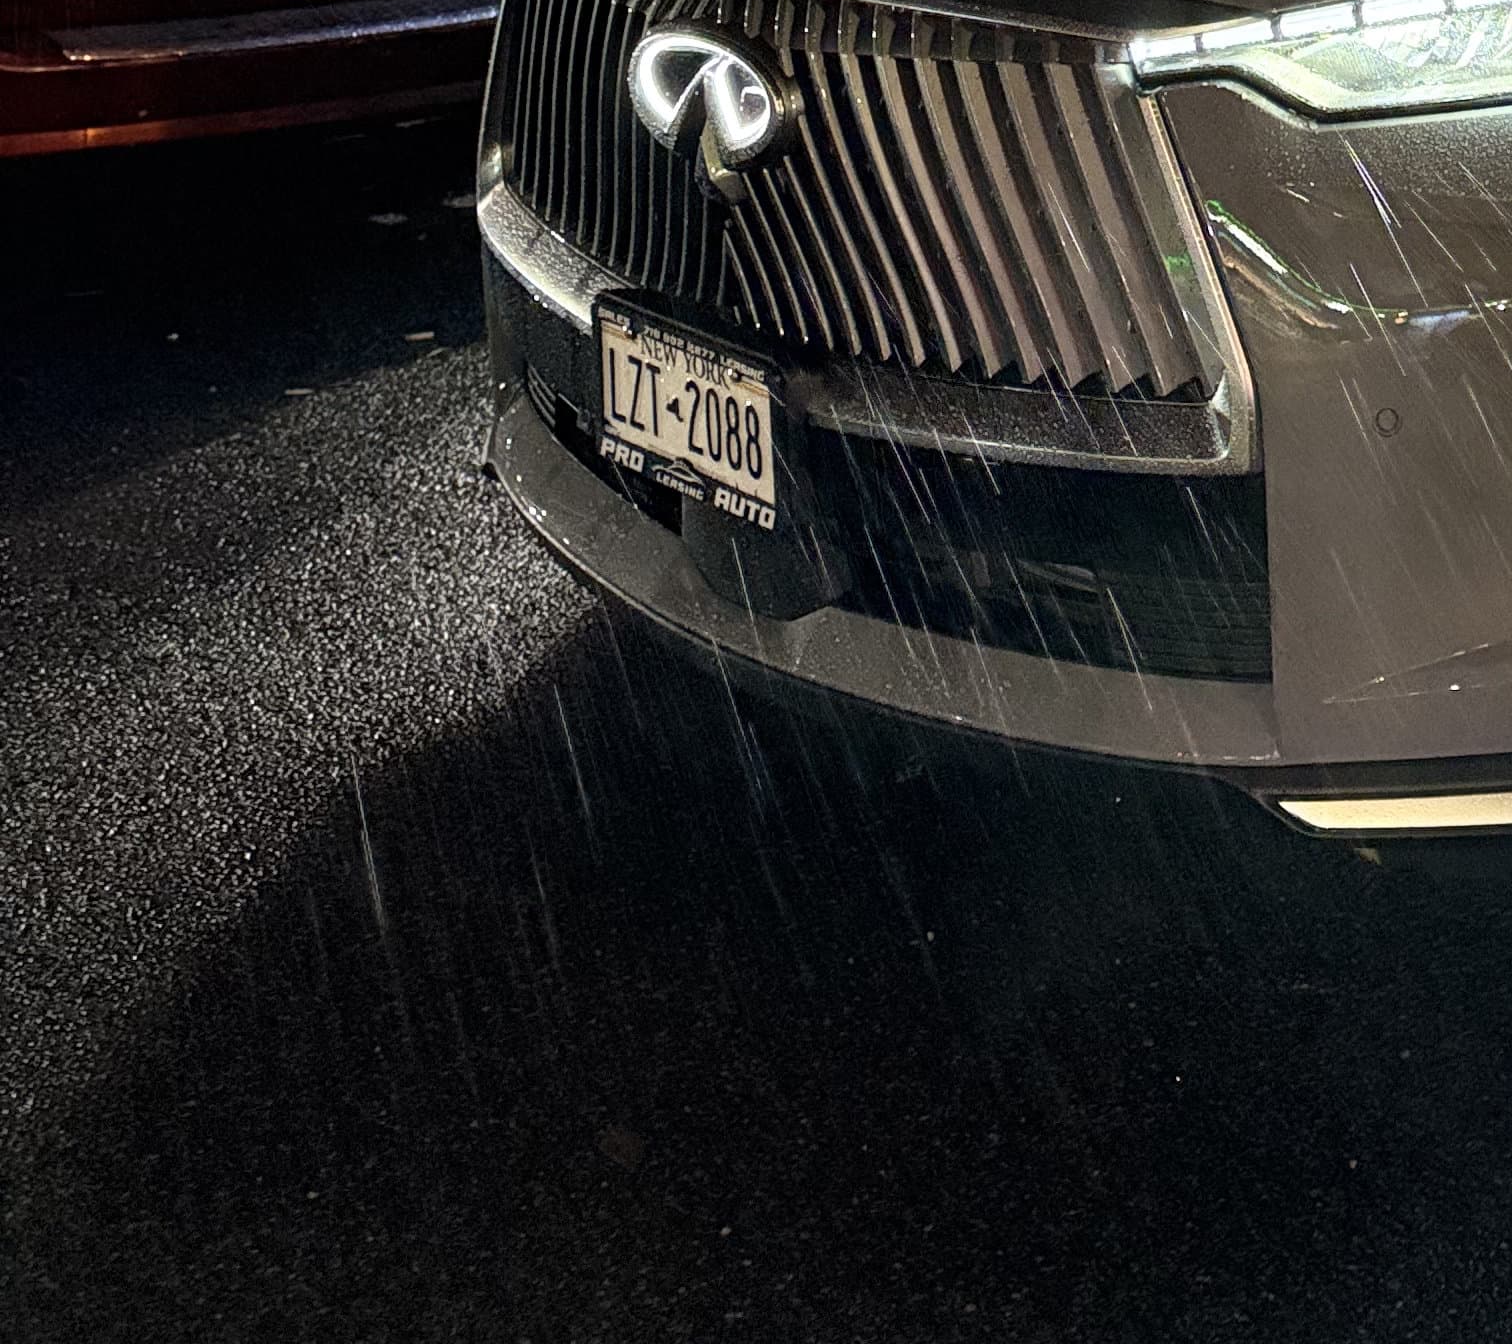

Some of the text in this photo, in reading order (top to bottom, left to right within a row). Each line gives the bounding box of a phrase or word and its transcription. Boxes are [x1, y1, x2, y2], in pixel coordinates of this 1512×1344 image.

[640, 333, 731, 391] NEW YORK
[600, 436, 777, 532] PRO LEASING AUTO
